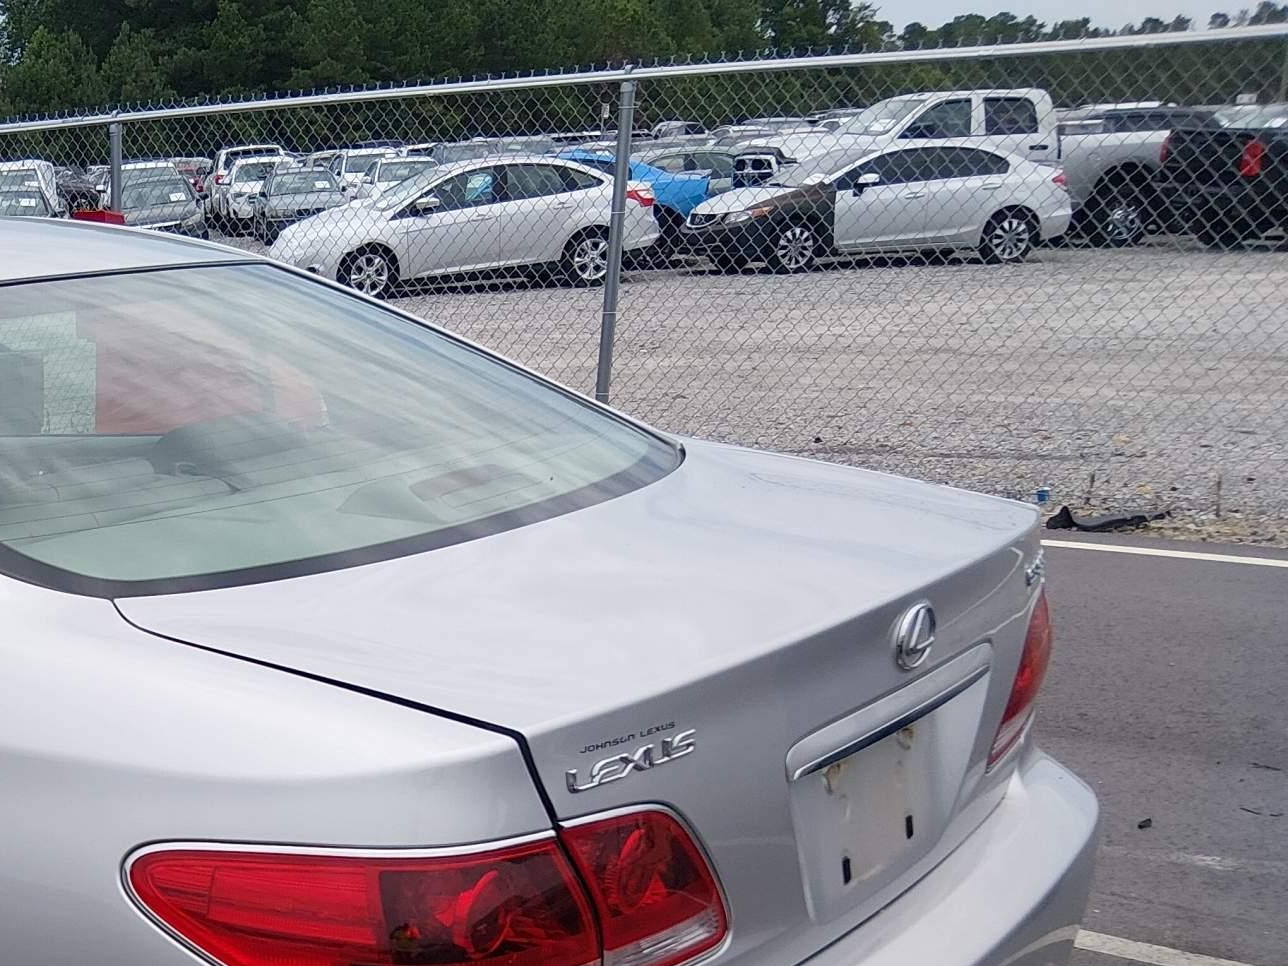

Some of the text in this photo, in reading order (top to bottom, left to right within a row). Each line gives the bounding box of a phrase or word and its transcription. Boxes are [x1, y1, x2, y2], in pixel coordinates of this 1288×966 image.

[565, 728, 696, 794] LEXUS
[579, 721, 676, 754] JOHNSON LEXUS
